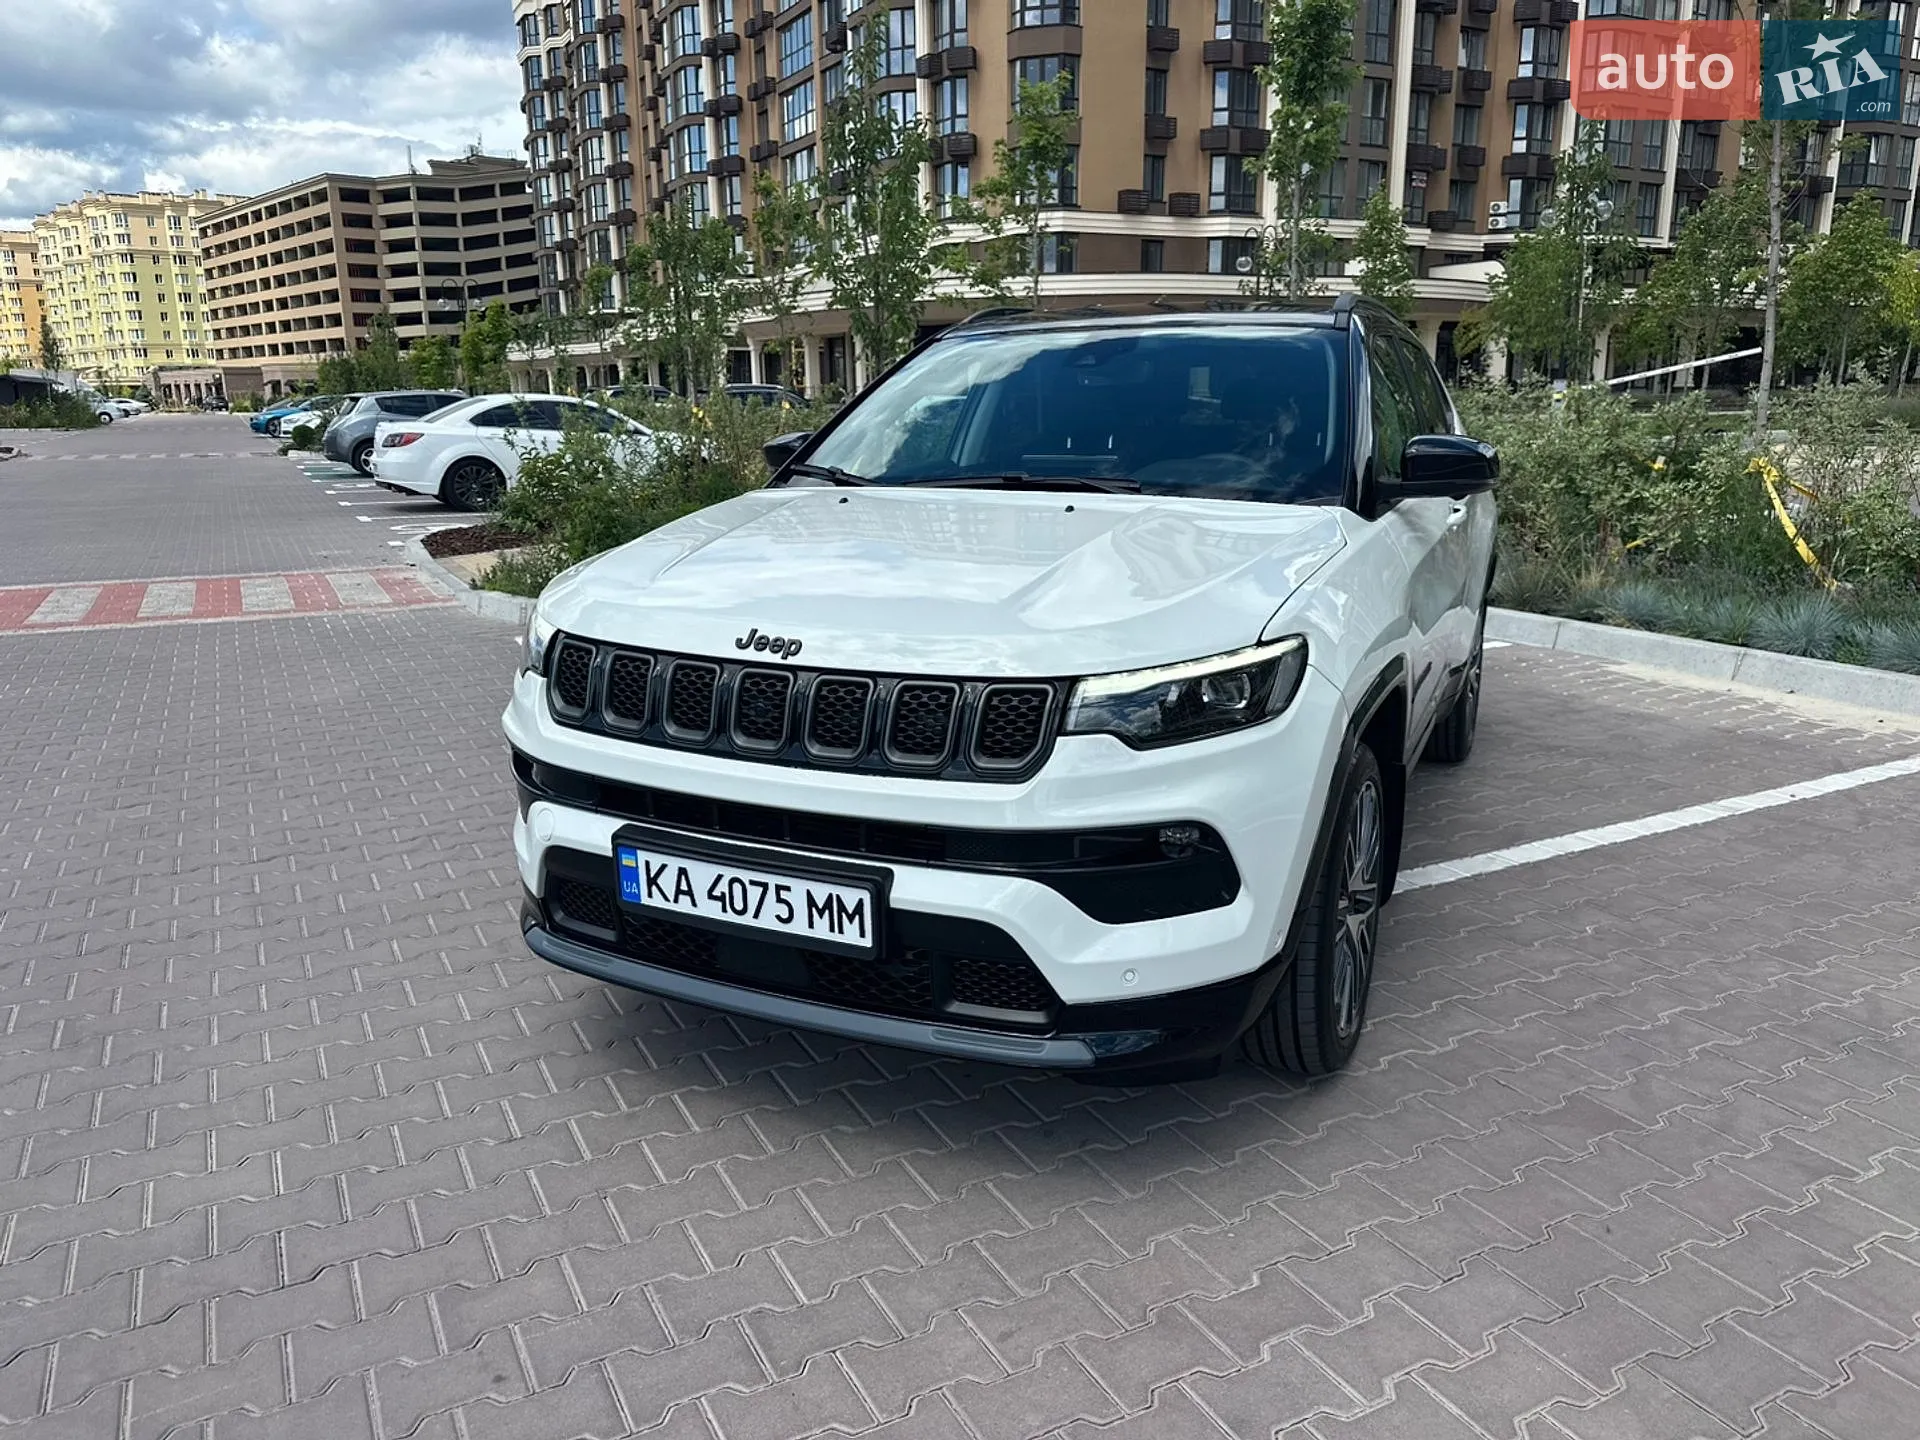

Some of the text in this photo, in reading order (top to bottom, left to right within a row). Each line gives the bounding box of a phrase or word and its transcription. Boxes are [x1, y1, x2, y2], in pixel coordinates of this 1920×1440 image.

[735, 628, 802, 660] Jeep
[623, 880, 639, 894] UA
[645, 860, 866, 938] KA 4075 MM
